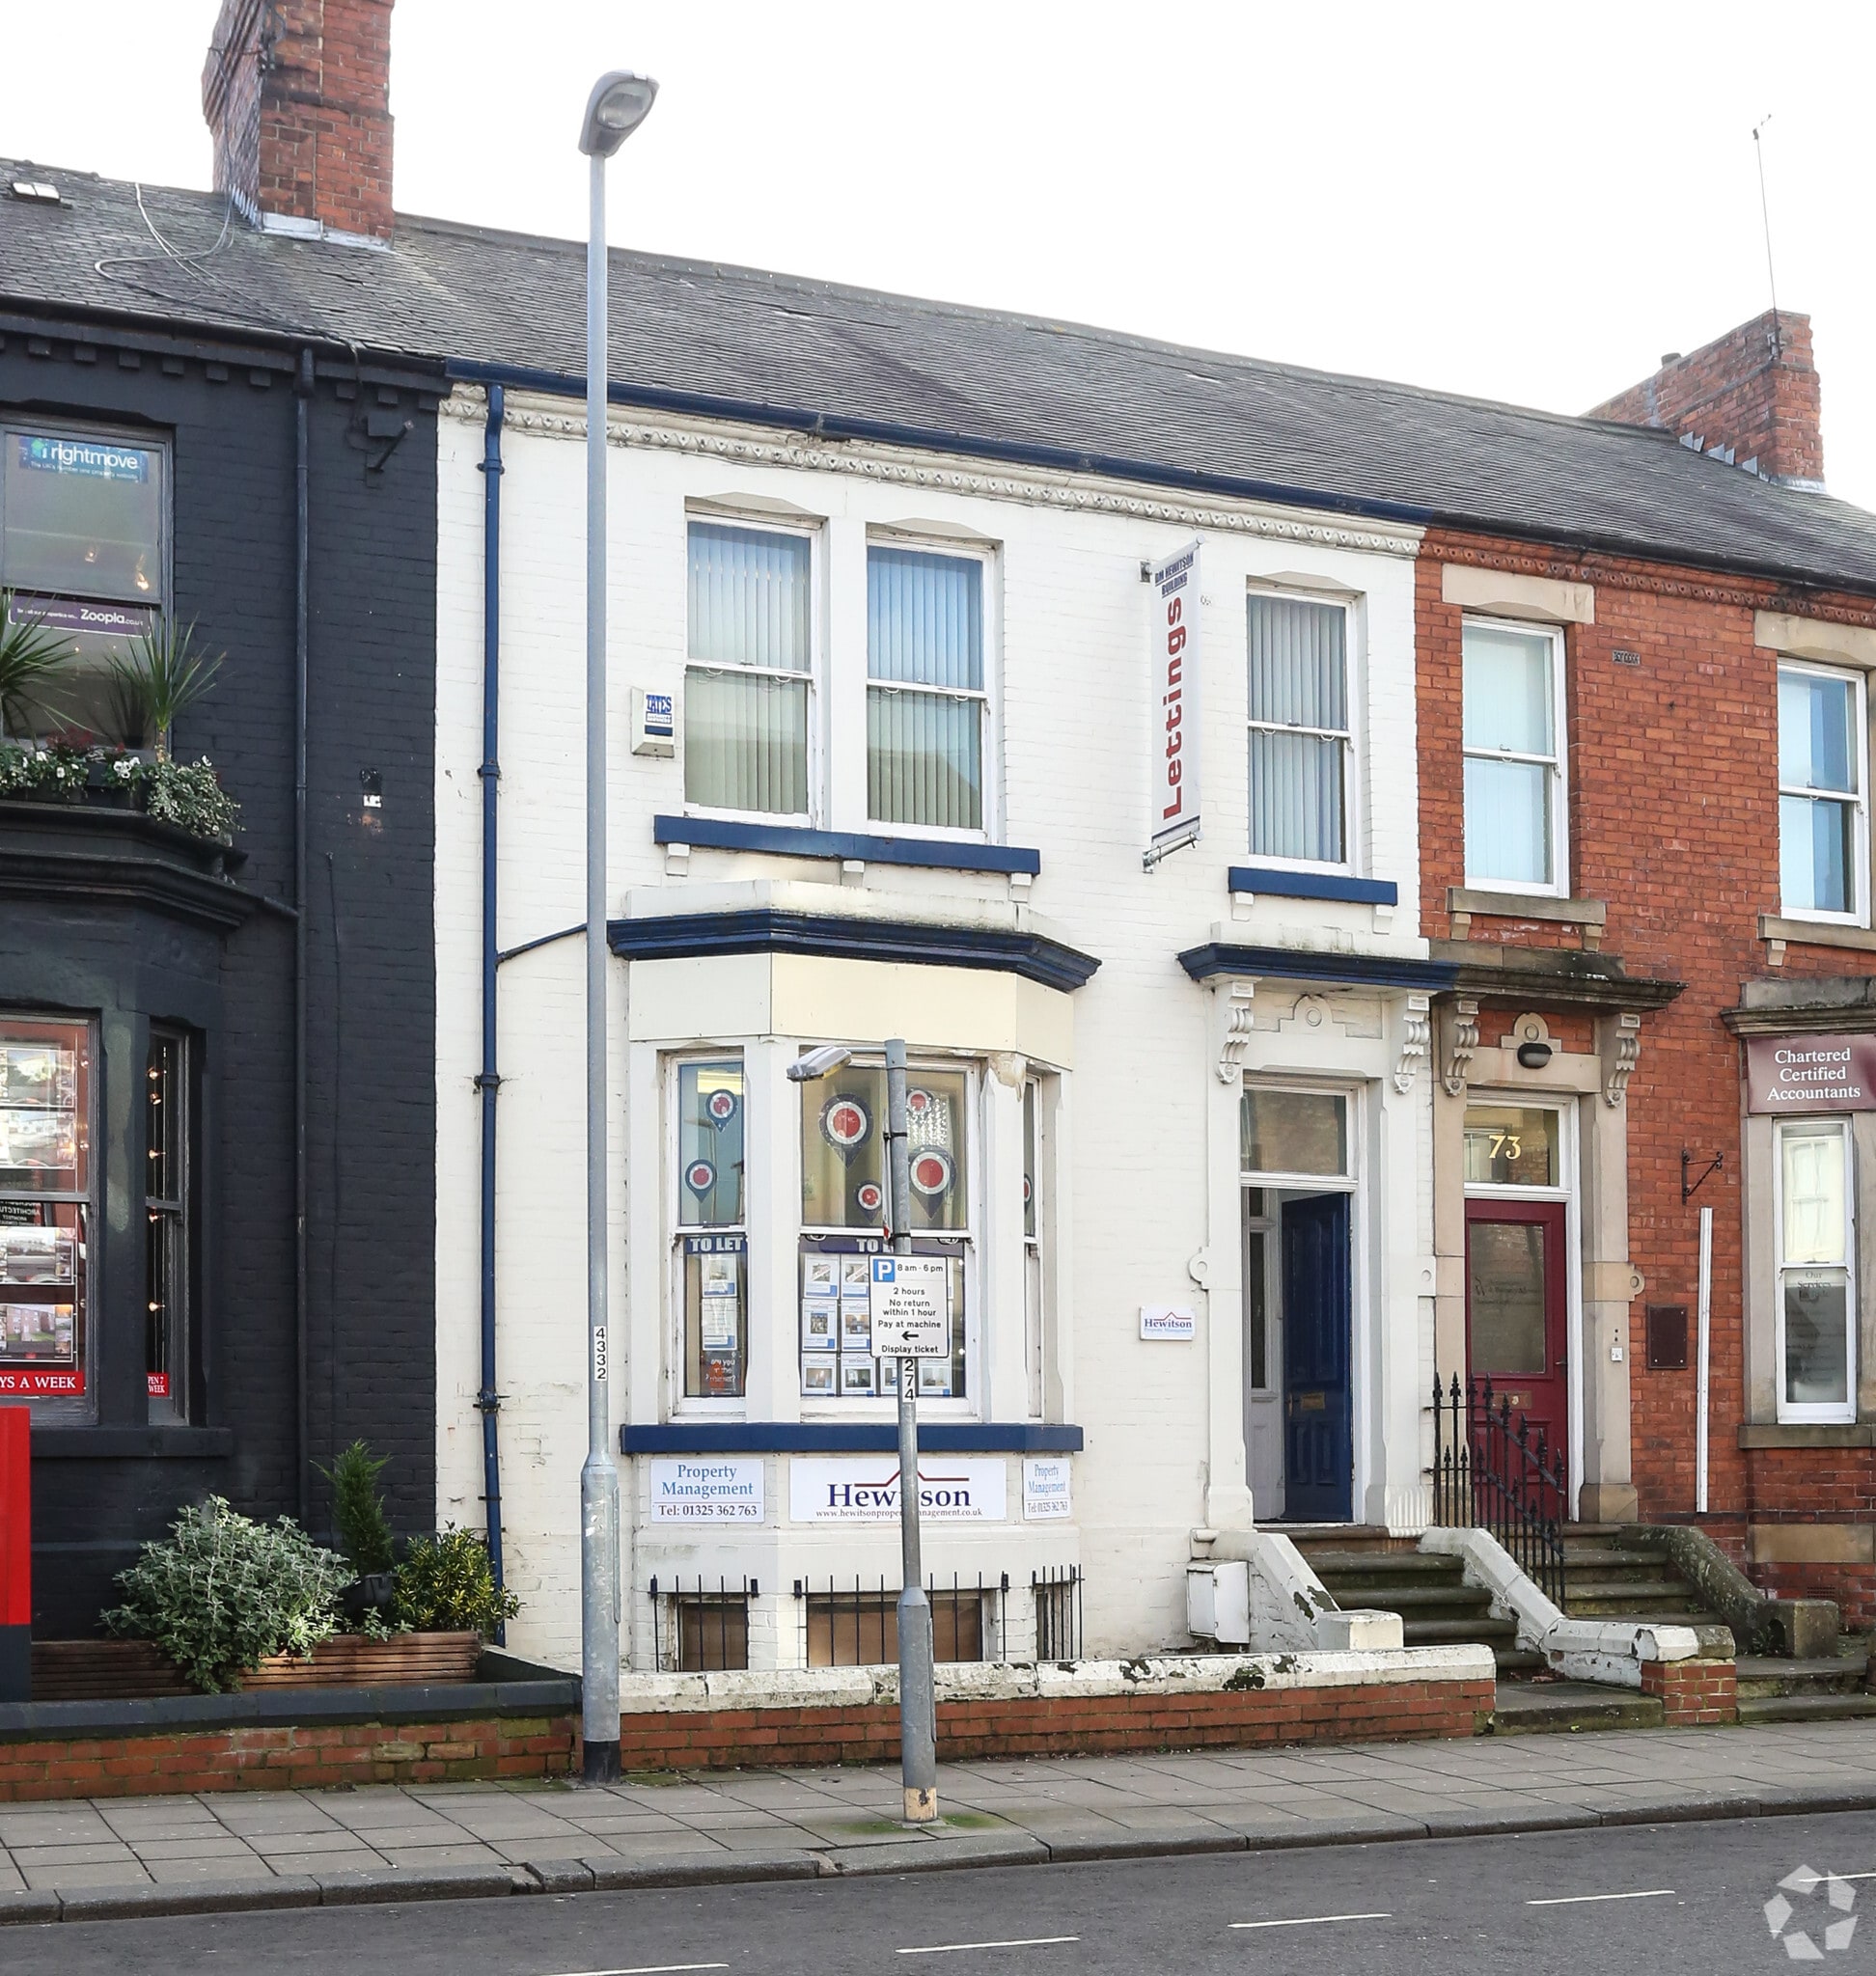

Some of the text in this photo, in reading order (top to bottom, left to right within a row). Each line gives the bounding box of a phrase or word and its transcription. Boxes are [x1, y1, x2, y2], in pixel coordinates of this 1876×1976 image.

[51, 443, 139, 470] rightmove
[1163, 595, 1186, 820] Lettings
[1775, 1047, 1851, 1063] Chartered
[1779, 1066, 1847, 1082] Certified
[1767, 1086, 1862, 1101] Accountants
[1488, 1135, 1522, 1160] 73
[690, 1237, 744, 1252] TO LET
[856, 1238, 879, 1253] TO
[893, 1286, 925, 1296] 2 hours
[877, 1319, 894, 1330] Pay
[906, 1320, 942, 1329] machine
[1145, 1318, 1193, 1329] Hewitson
[595, 1327, 606, 1380] 4332
[881, 1345, 913, 1354] Display
[0, 1376, 76, 1388] YS A WEEK
[148, 1376, 158, 1385] PEN
[904, 1358, 915, 1401] 274
[148, 1385, 165, 1393] WEEK
[677, 1465, 737, 1482] Property
[1035, 1464, 1060, 1481] Property
[661, 1482, 754, 1499] Management
[827, 1484, 972, 1507] Hewson
[1028, 1480, 1066, 1496] Management
[658, 1505, 758, 1516] Tel: 01325 362 763
